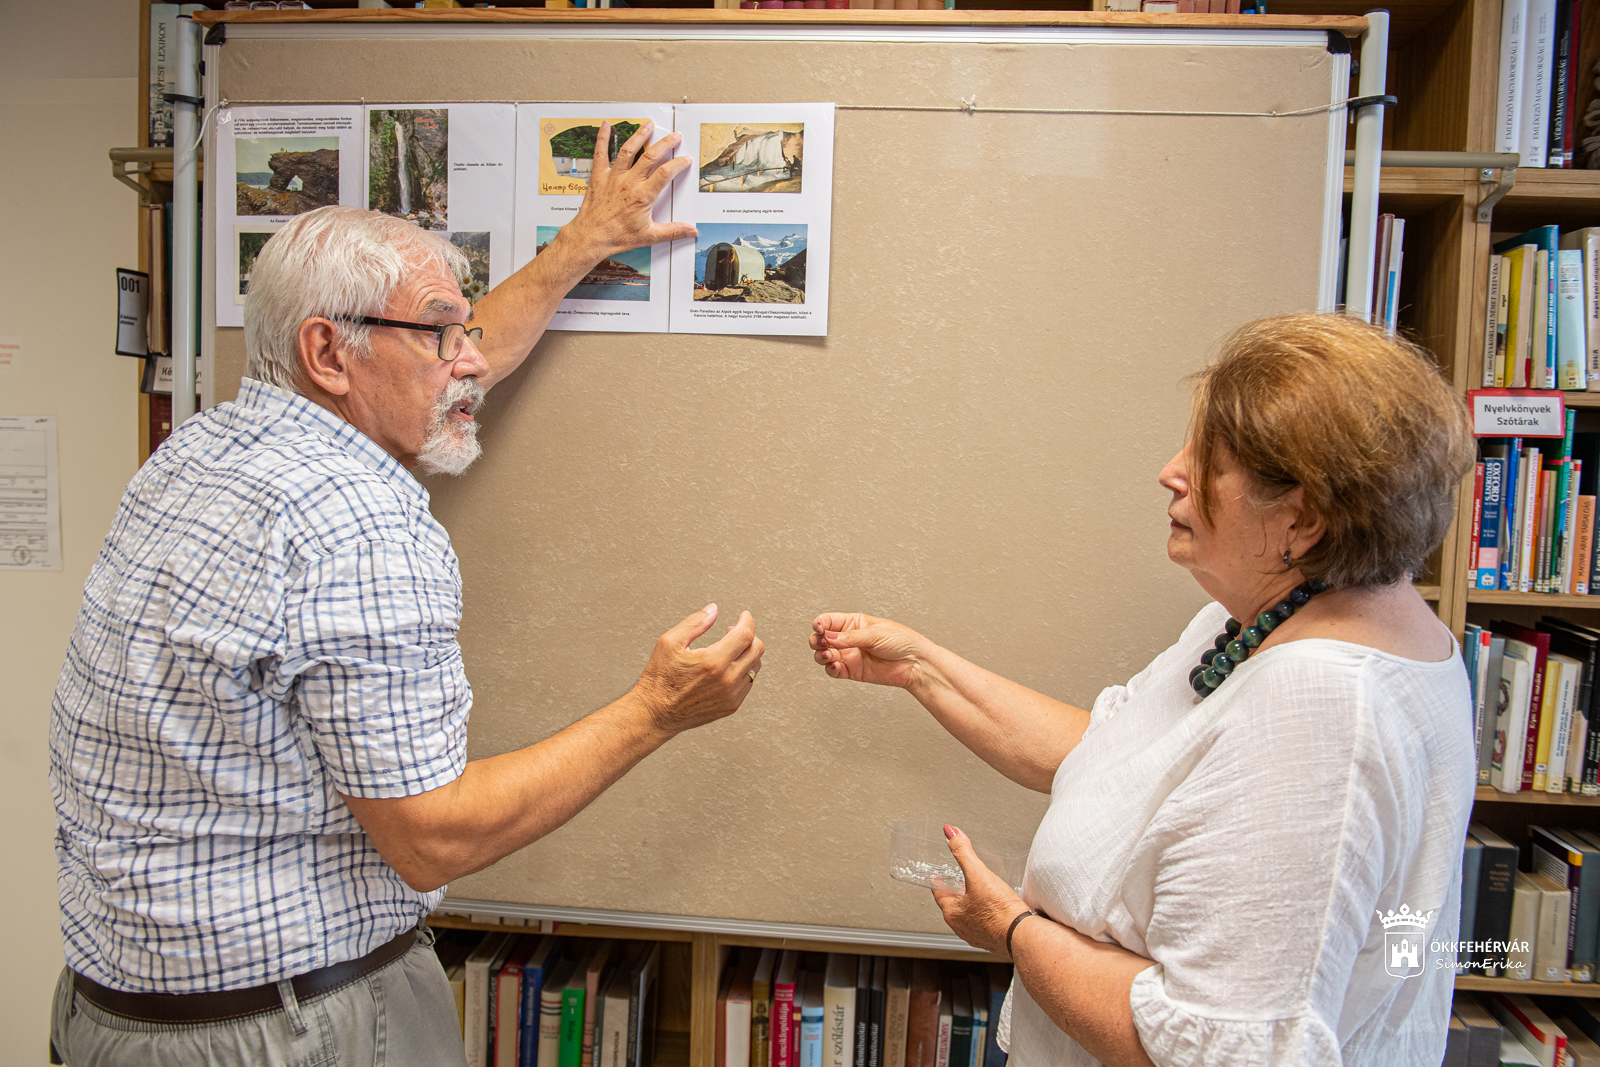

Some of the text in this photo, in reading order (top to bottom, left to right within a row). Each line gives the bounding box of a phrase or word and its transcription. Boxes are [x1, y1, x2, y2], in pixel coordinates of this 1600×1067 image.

[158, 22, 166, 114] BUDAPEST LEXIKON
[1507, 46, 1518, 102] MAGYARORSZÁG
[1534, 46, 1545, 102] MAGYARORSZÁG
[1556, 58, 1567, 116] MAGYARORSZÁG
[1506, 104, 1514, 140] EMLÉKEZŐ
[1532, 104, 1541, 140] EMLÉKEZŐ
[1554, 117, 1562, 141] VÉRZŐ
[568, 182, 588, 194] Євро
[120, 276, 140, 293] 001
[1488, 320, 1496, 359] GYAKORLATI
[1484, 404, 1552, 415] Nyelvkönyvek
[1496, 416, 1539, 426] Szótárak
[1492, 462, 1502, 503] OXFORD
[778, 1003, 789, 1058] enciklopédiája
[832, 1004, 844, 1056] szólástár
[870, 1023, 878, 1067] llentétszótár
